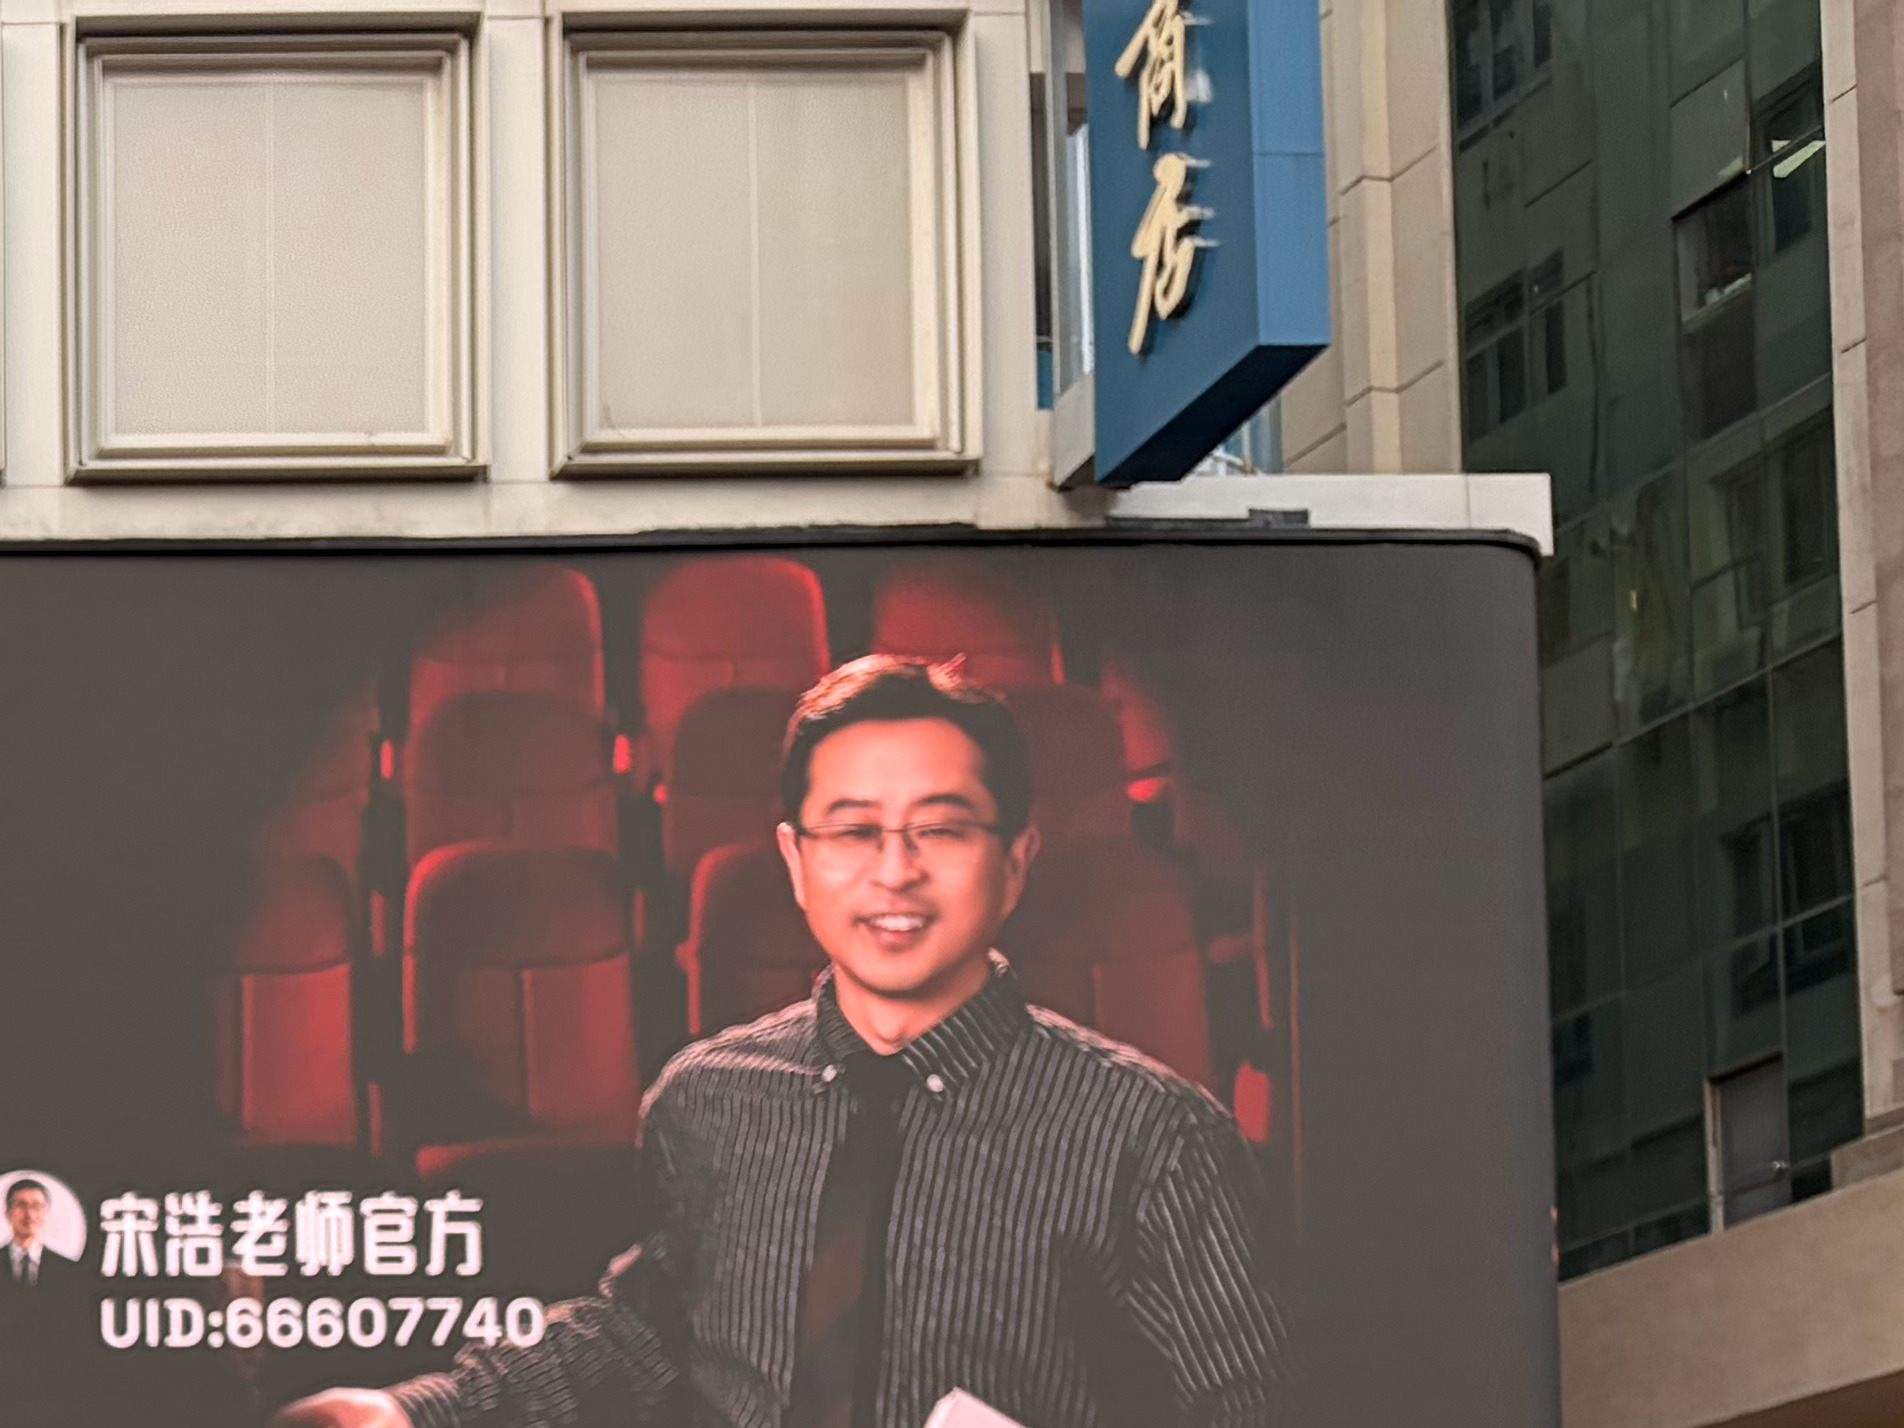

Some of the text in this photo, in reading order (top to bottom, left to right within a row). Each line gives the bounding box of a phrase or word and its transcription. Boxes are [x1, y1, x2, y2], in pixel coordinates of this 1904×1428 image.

[100, 1190, 483, 1277] 宋浩老师官方
[100, 1297, 545, 1349] UID:66607740
